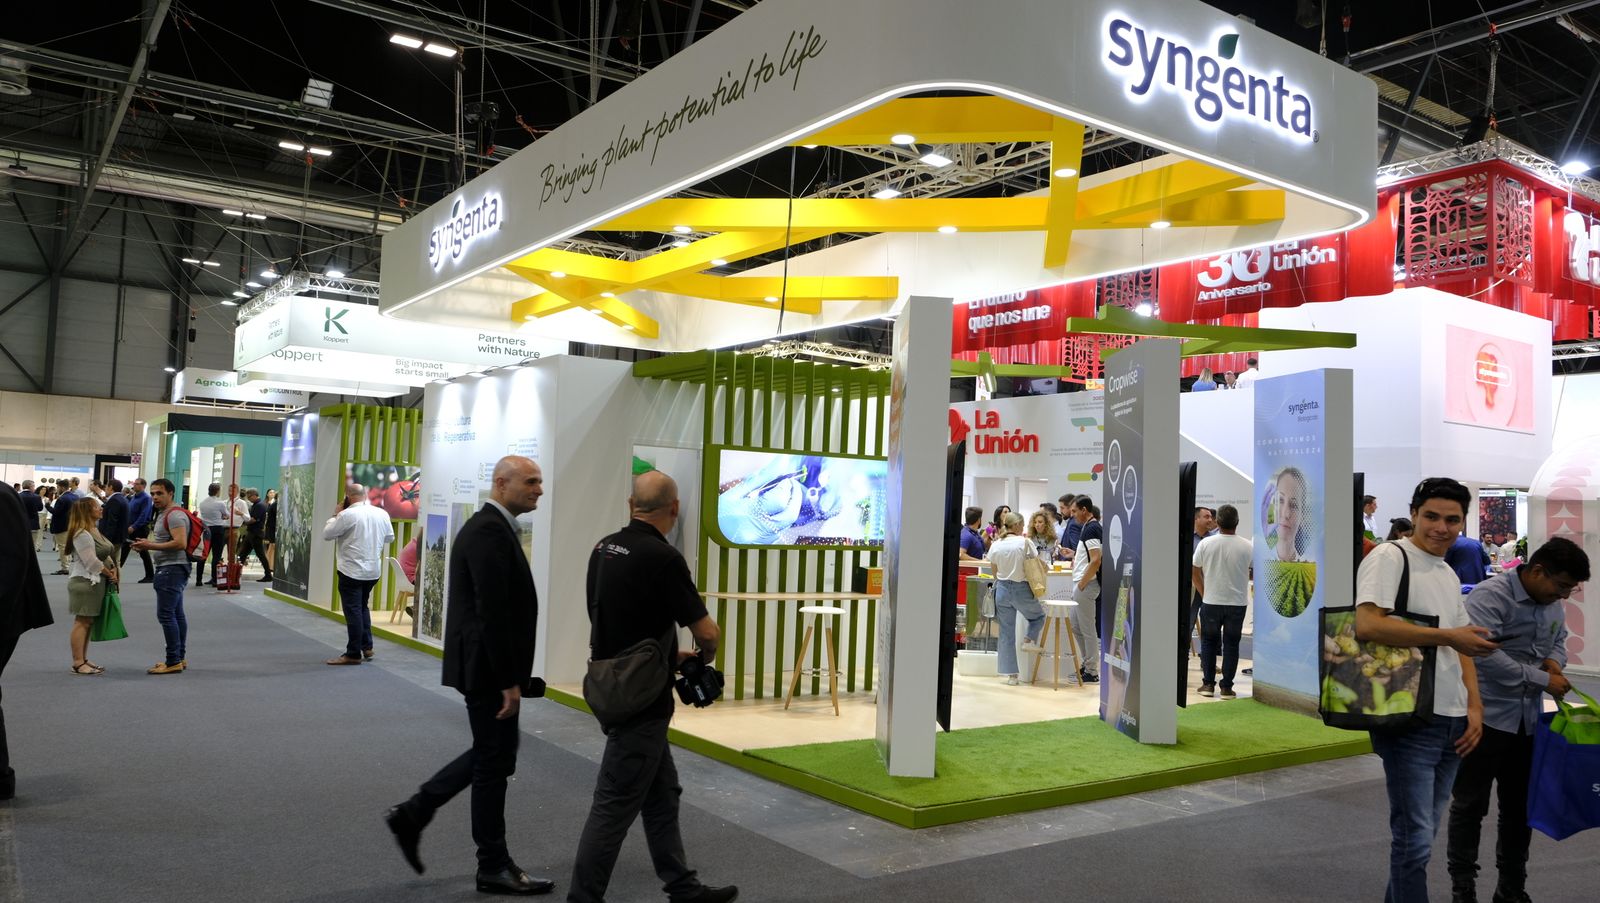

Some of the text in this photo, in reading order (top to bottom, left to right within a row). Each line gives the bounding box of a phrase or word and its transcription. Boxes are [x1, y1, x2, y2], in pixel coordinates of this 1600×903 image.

[1108, 18, 1311, 137] syngenta
[538, 25, 828, 211] Bringing plant potential to life
[428, 196, 499, 269] syngenta
[1273, 245, 1337, 271] unión
[1197, 281, 1272, 301] Aniversario
[968, 304, 1052, 333] que nos une
[323, 335, 350, 344] Koppert
[478, 333, 527, 347] Partners
[271, 348, 323, 362] oppert
[477, 344, 541, 359] with Nature
[395, 358, 444, 370] Big impact
[394, 368, 449, 379] starts small
[1108, 369, 1139, 395] Cropwise
[1288, 400, 1320, 416] syngenta
[974, 409, 1000, 429] La
[974, 428, 1039, 455] unión
[1256, 434, 1316, 446] COMPARTIMOS
[1268, 447, 1321, 456] NATURALEZA
